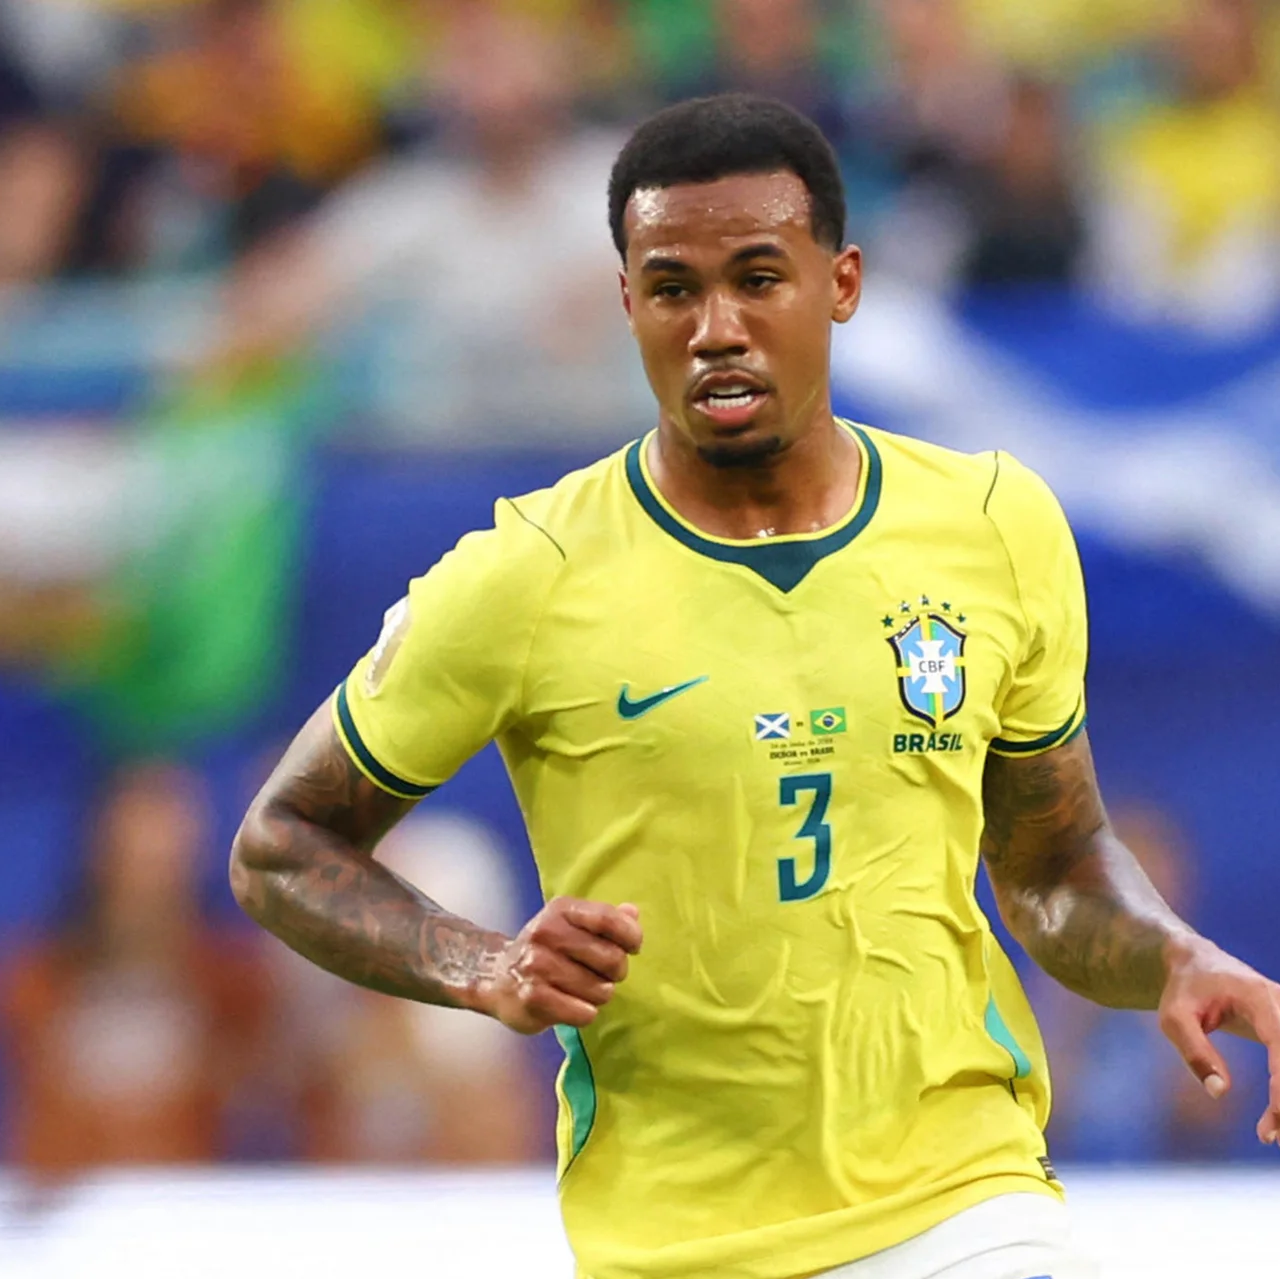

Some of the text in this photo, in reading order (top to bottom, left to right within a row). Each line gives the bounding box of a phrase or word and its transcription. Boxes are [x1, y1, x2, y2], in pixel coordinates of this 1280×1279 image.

[918, 660, 946, 674] CBF
[893, 732, 963, 753] BRASIL
[777, 773, 832, 902] 3
